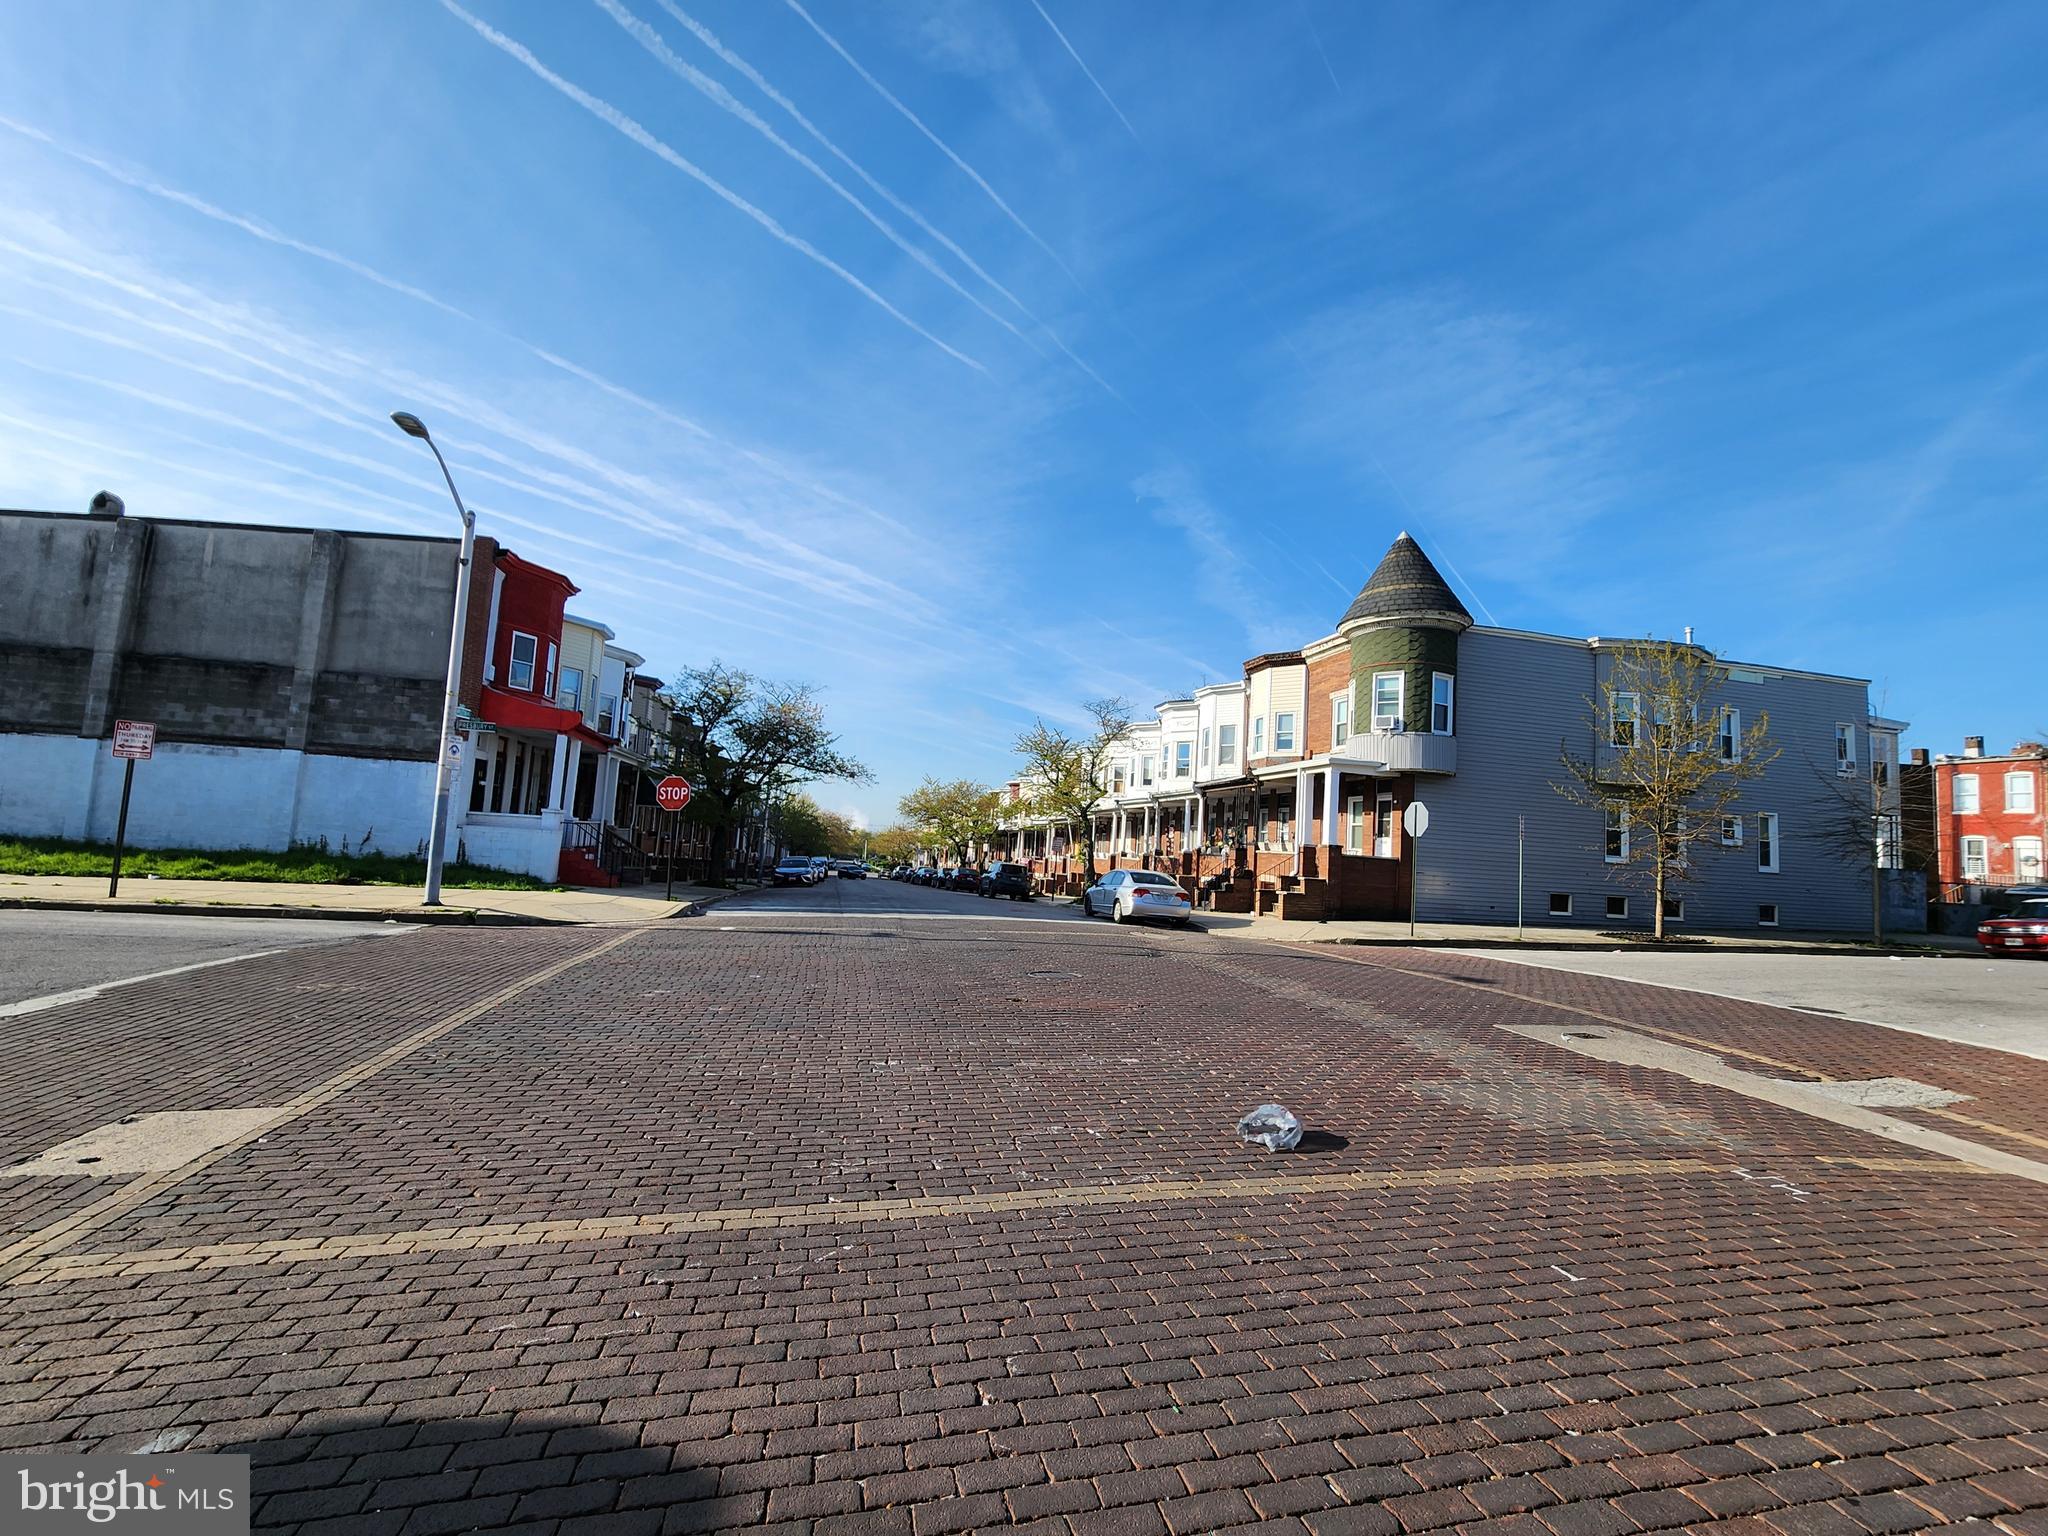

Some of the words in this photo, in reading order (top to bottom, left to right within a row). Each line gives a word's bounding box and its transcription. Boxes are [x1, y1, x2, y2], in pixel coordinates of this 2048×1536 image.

[118, 722, 130, 730] NO
[118, 731, 152, 739] THURSDAY
[659, 787, 688, 800] STOP
